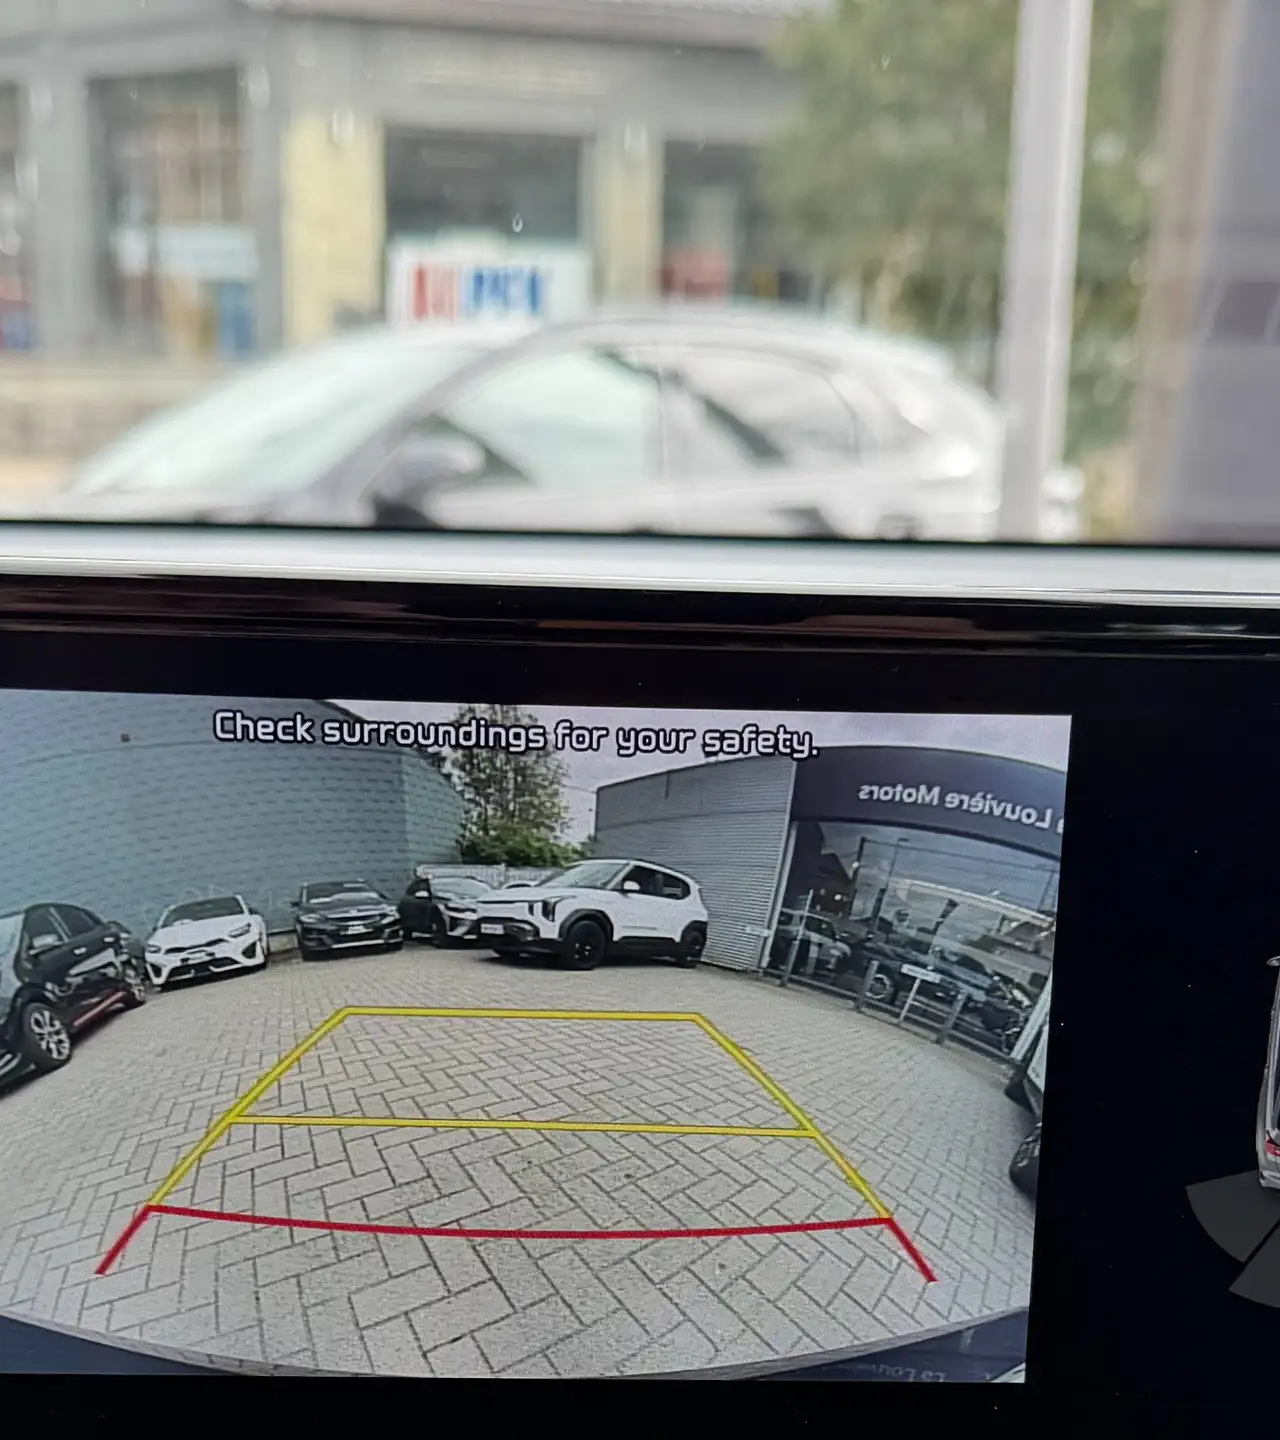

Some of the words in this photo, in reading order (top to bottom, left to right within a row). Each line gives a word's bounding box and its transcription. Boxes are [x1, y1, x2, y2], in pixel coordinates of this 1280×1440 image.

[214, 710, 315, 743] Check
[323, 719, 546, 752] surroundings
[555, 721, 609, 751] for
[617, 728, 696, 756] your
[704, 725, 819, 759] safety.
